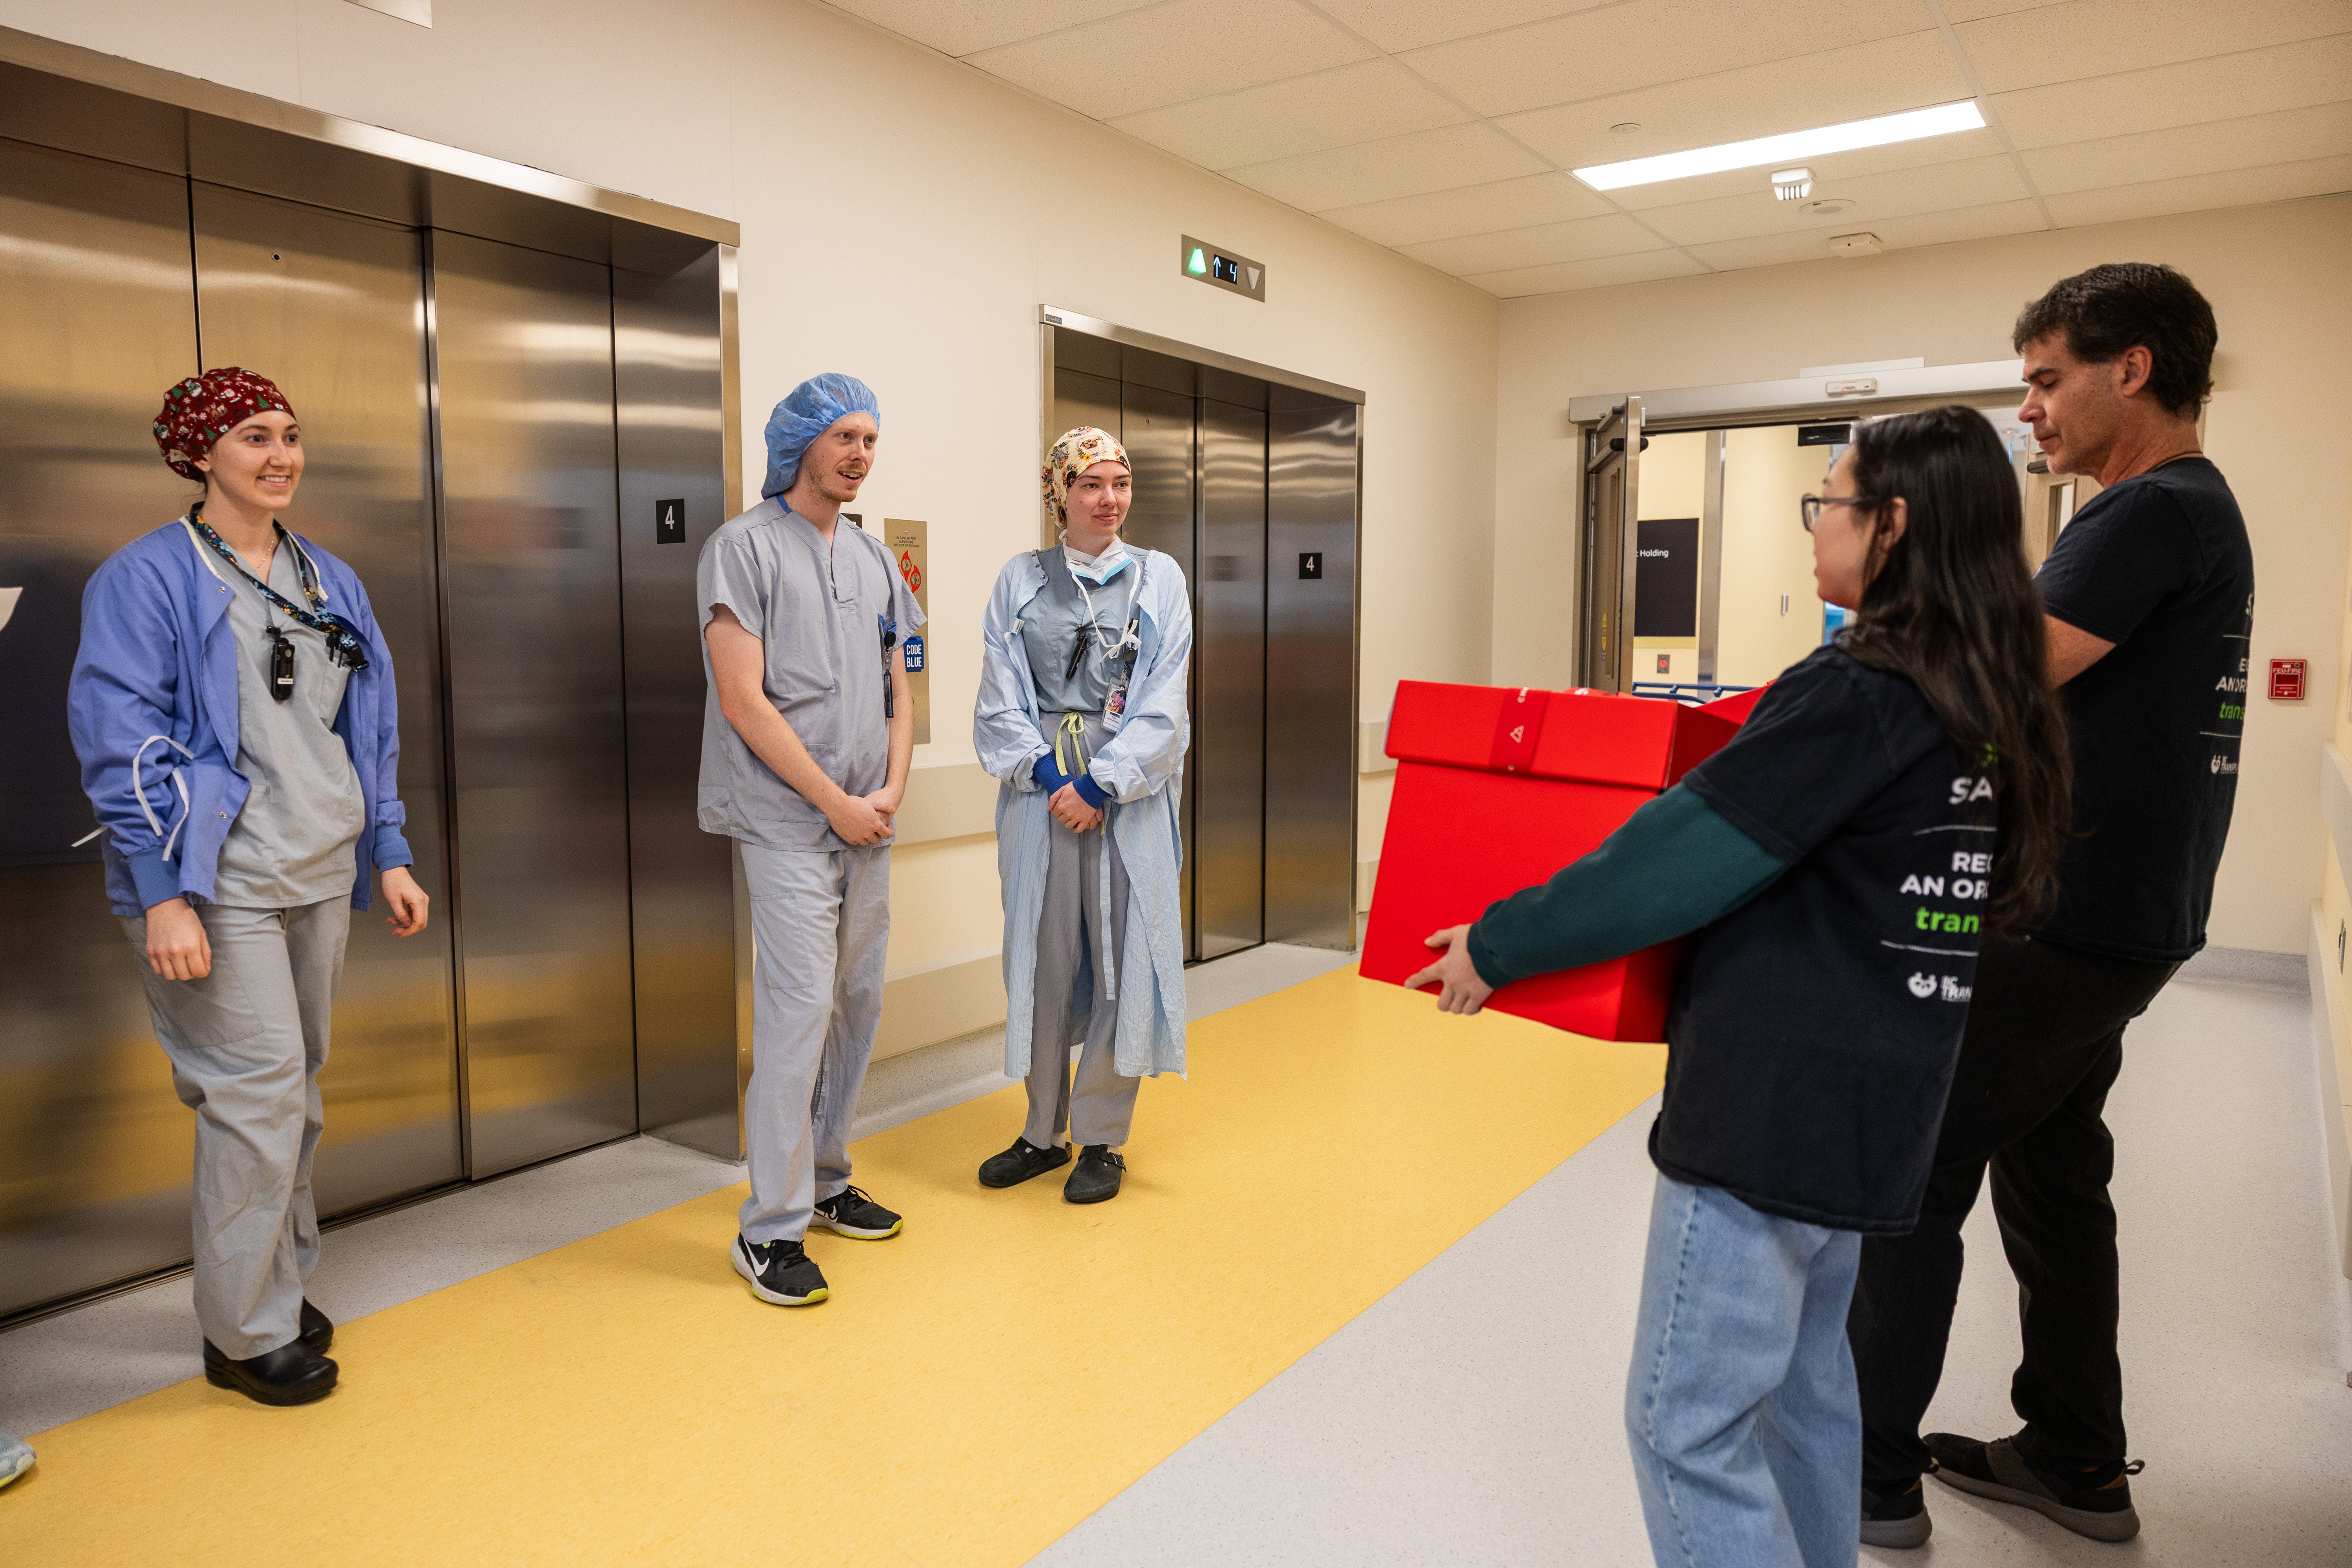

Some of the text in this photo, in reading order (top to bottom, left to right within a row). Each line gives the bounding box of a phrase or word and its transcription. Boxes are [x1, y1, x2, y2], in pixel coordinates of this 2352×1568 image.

[1230, 263, 1238, 281] 4
[665, 505, 674, 529] 4
[1640, 549, 1669, 558] Holding
[1306, 556, 1314, 571] 4
[906, 644, 922, 655] CODE
[906, 657, 922, 668] BLUE
[1948, 776, 1993, 805] SA
[1900, 873, 1945, 897] AN
